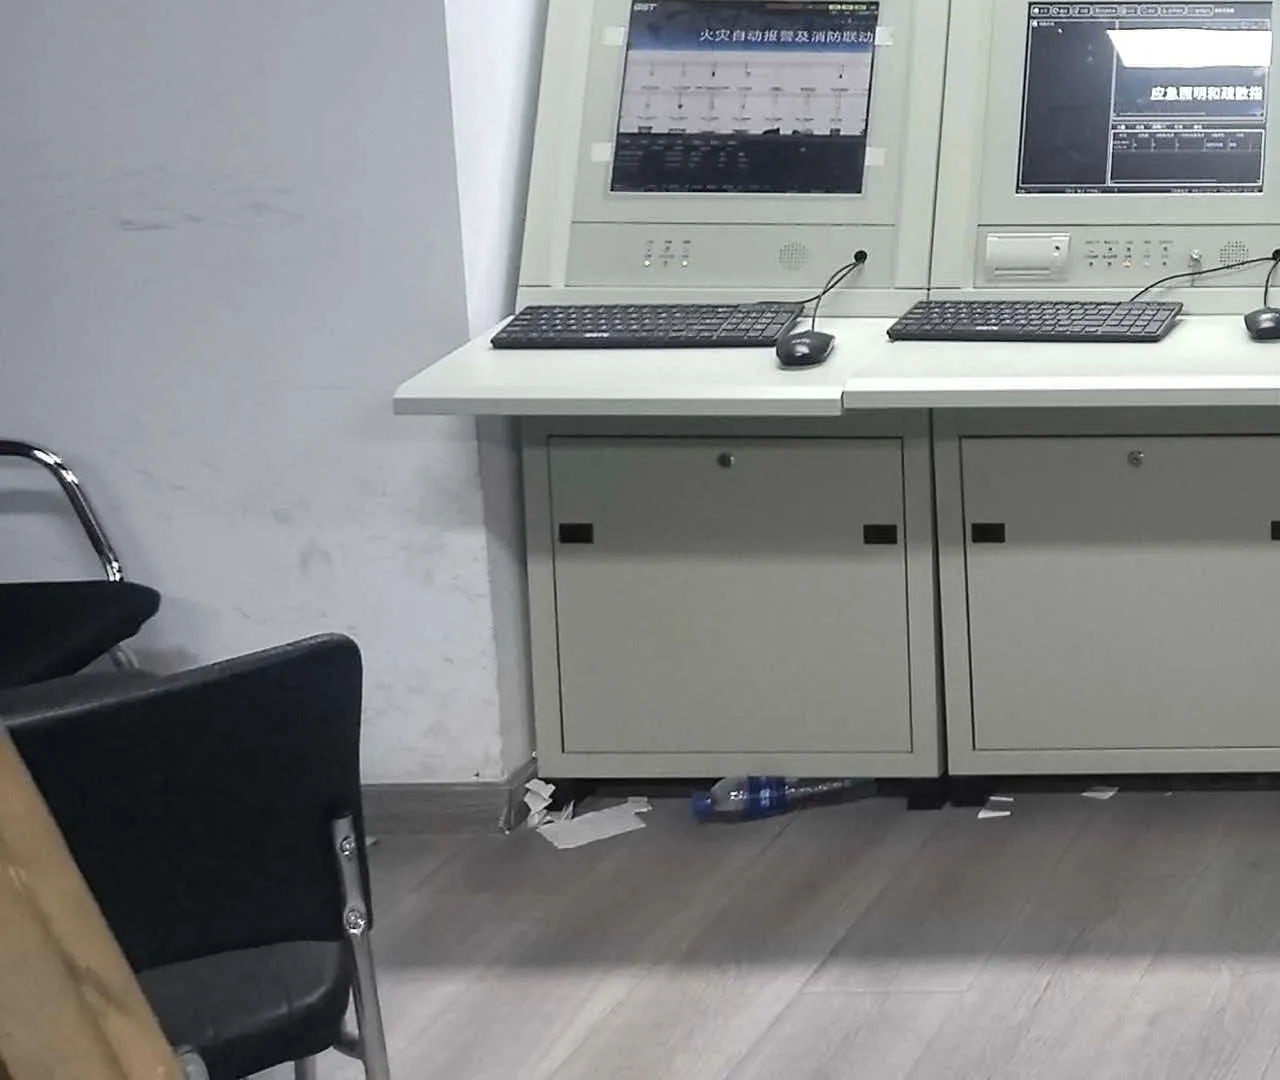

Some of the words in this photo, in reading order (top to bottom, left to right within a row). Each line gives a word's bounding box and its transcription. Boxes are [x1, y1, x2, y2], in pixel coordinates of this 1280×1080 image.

[700, 28, 873, 43] 火灾自动报警及消防联动
